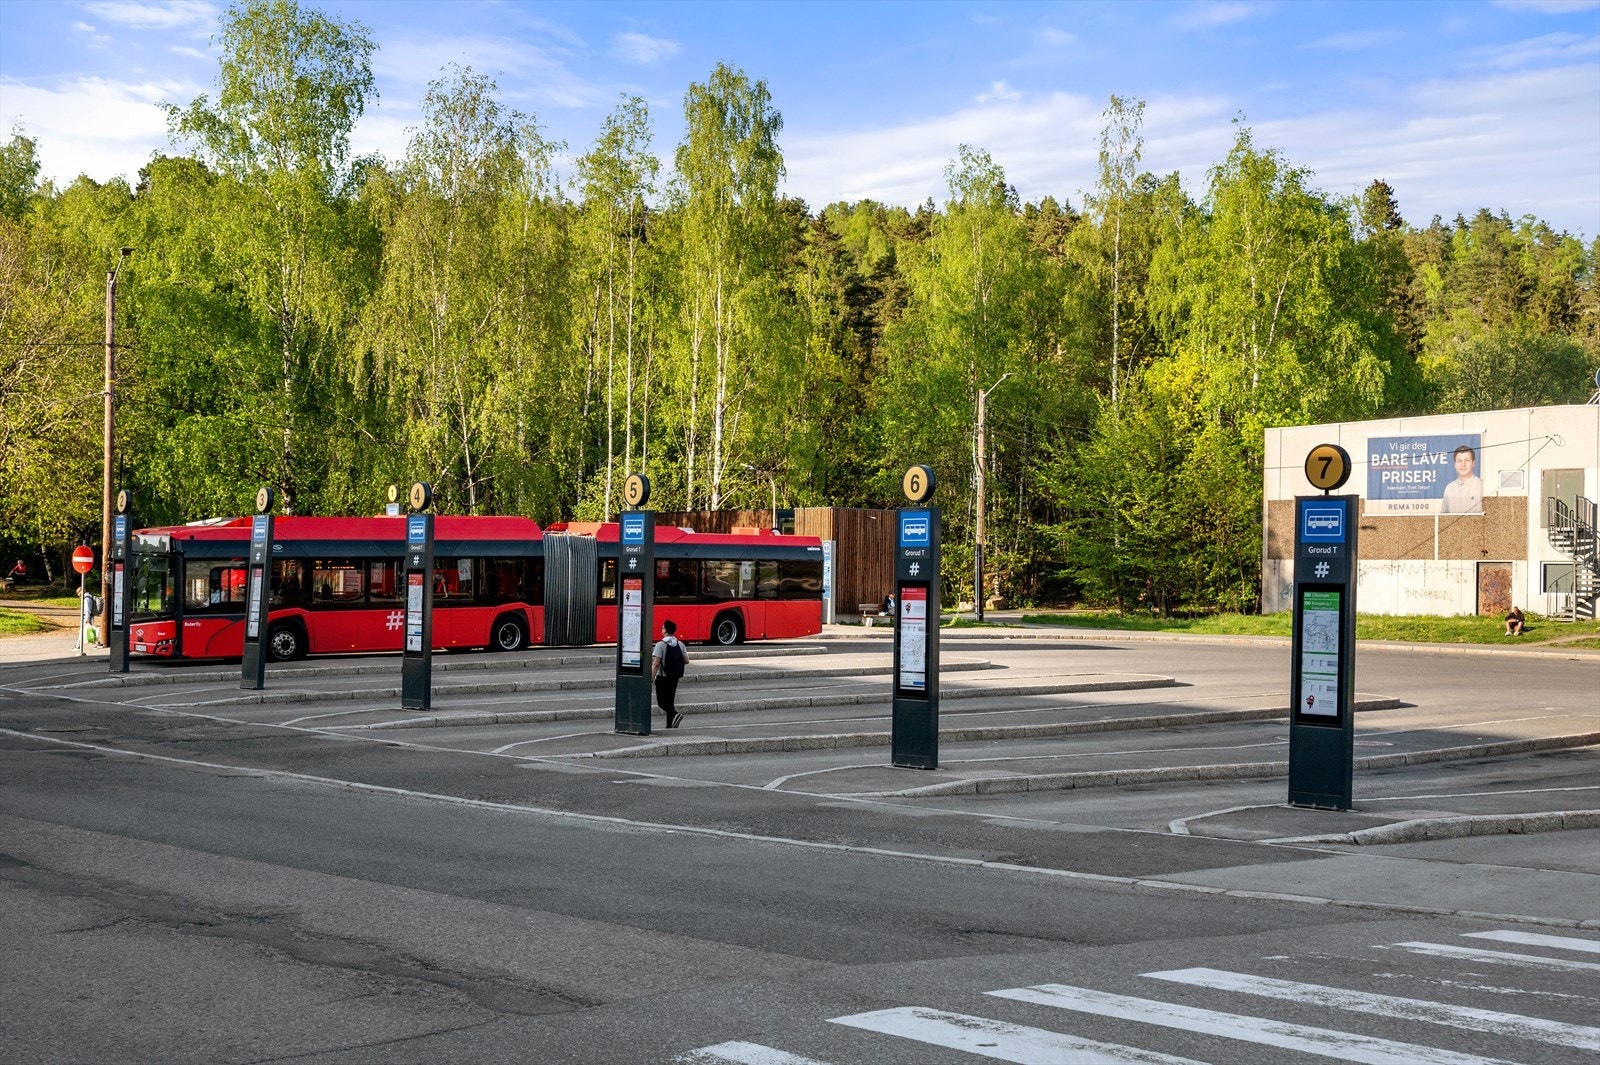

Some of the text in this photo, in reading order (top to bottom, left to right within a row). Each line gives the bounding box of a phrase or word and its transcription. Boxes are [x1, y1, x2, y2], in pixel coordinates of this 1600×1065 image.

[1400, 443, 1410, 451] gir
[1412, 442, 1427, 451] deg
[1371, 451, 1448, 466] BARE LAVE
[1317, 456, 1333, 479] 7
[910, 474, 920, 493] 6
[1382, 470, 1437, 483] PRISER!
[414, 488, 421, 503] 4
[629, 482, 637, 499] 5
[259, 493, 265, 507] 3
[1308, 546, 1332, 554] Grorud
